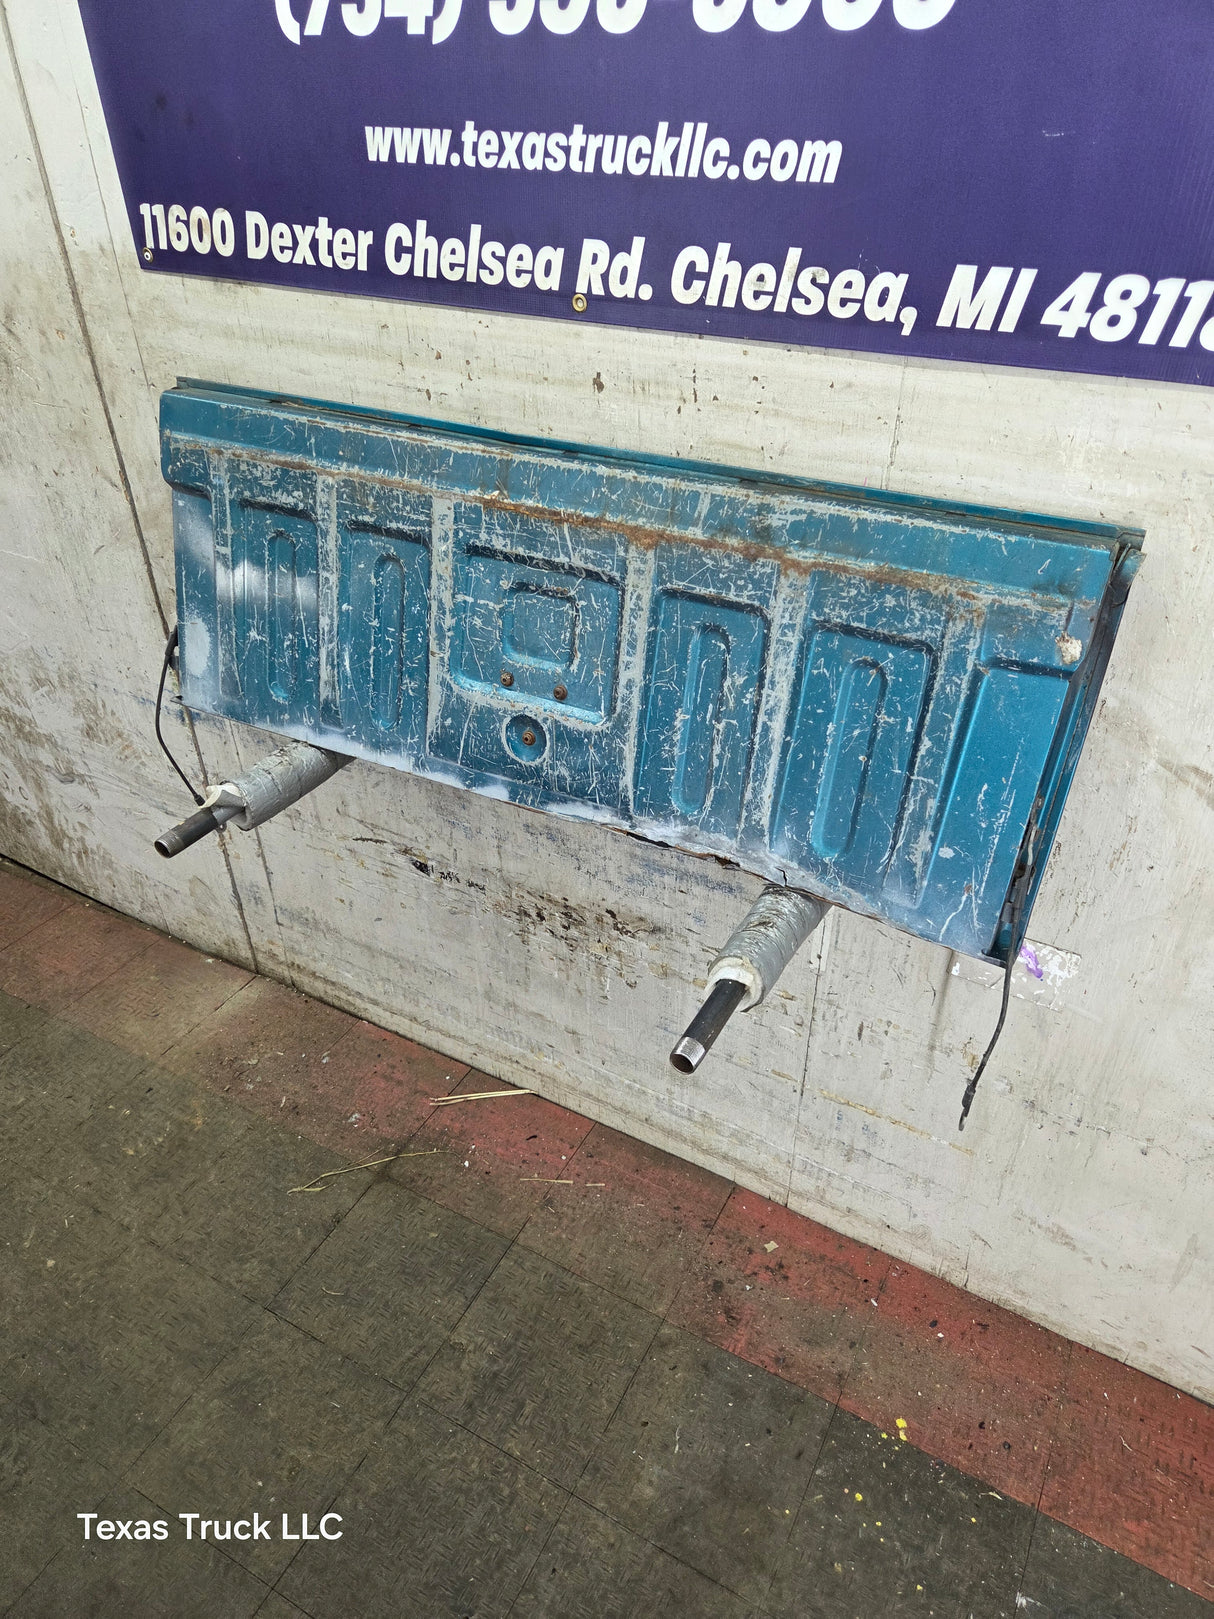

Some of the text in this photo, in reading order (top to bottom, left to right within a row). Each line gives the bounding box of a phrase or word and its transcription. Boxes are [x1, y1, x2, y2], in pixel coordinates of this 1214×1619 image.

[364, 120, 843, 184] www.texastruckllc.com
[139, 202, 1214, 352] 11600 Dexter Chelsea Rd. Chelsea, MI 4811
